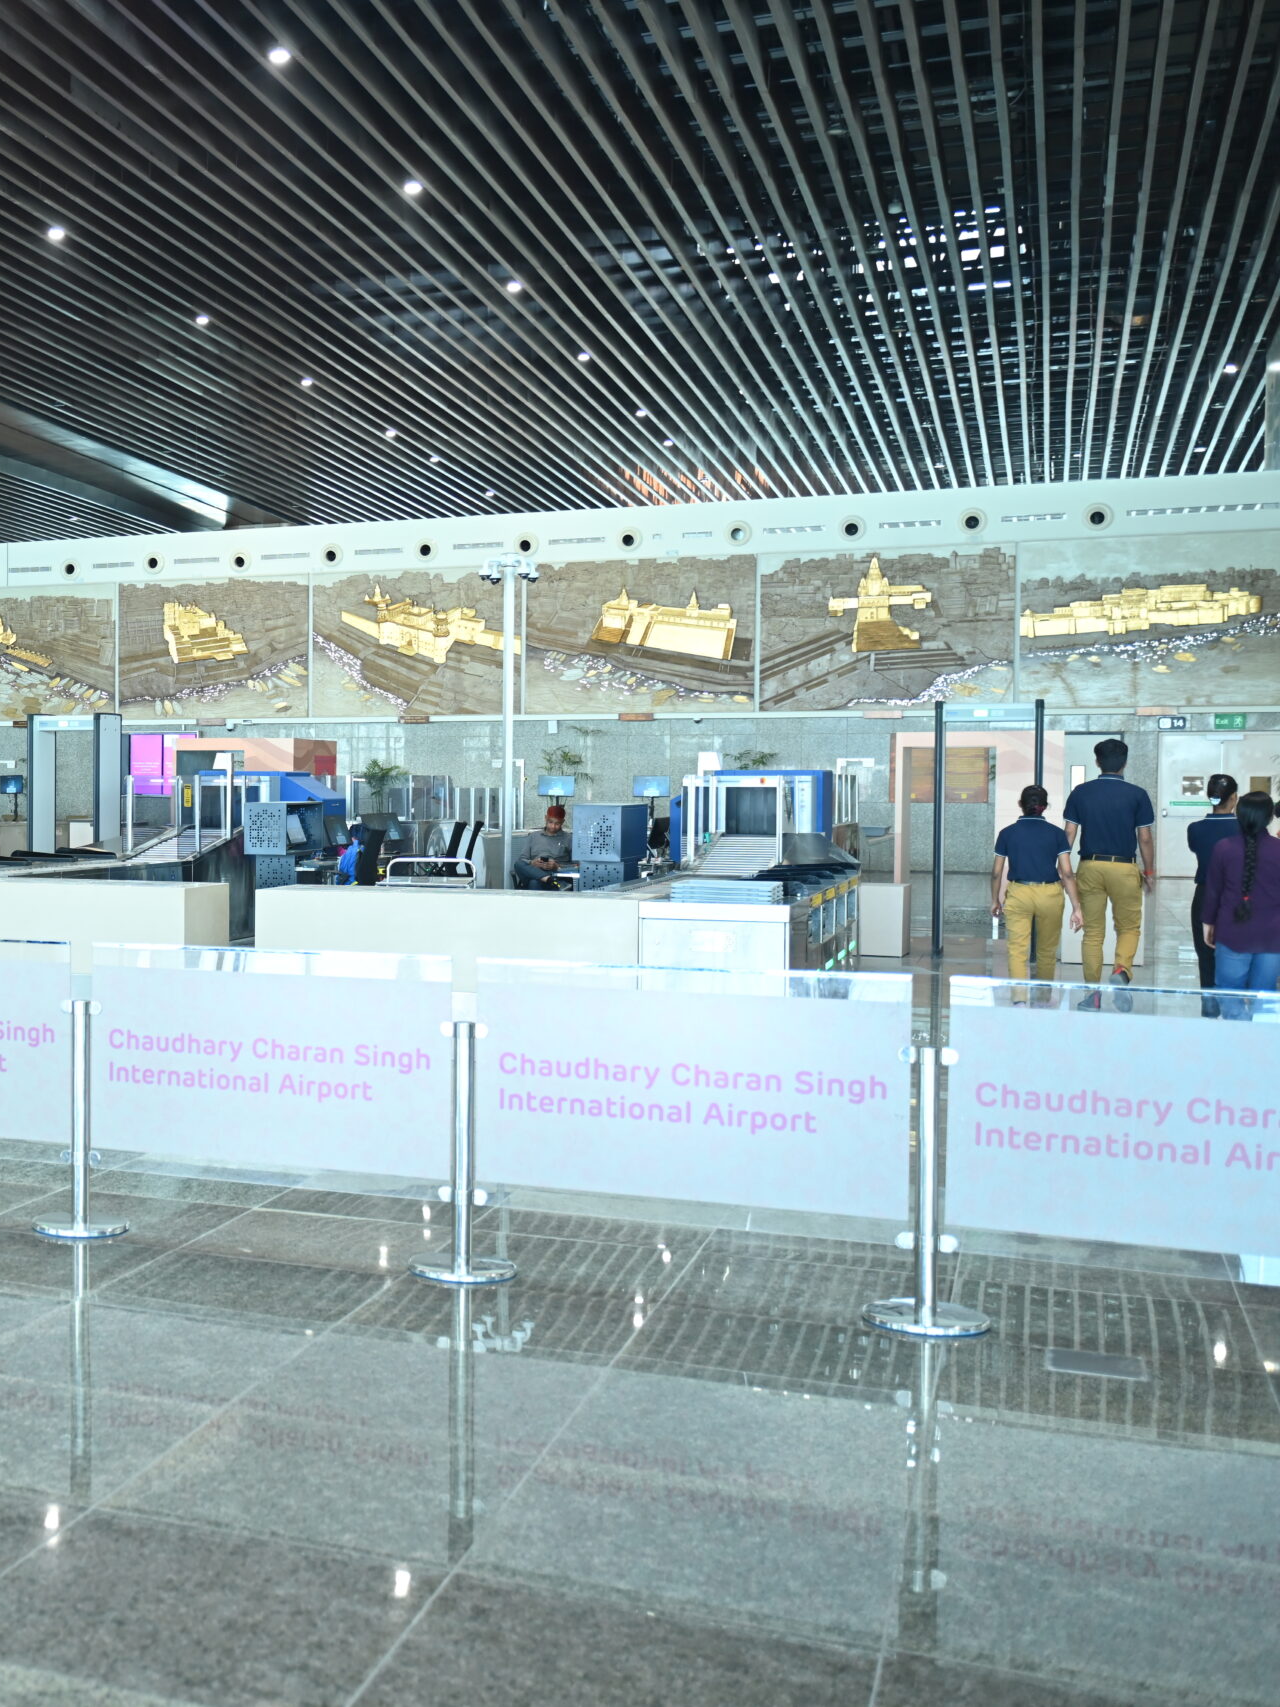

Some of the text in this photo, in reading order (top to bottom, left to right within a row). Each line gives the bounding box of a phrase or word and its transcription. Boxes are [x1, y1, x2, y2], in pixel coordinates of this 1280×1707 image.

[1172, 719, 1184, 727] 14
[108, 1028, 432, 1075] Chaudhary Charan Singh
[108, 1062, 373, 1103] International Airport
[498, 1052, 888, 1104] Chaudhary Charan Singh
[498, 1087, 817, 1134] International Airport
[975, 1082, 1280, 1129] Chaudhary Char
[975, 1121, 1280, 1171] International Air
